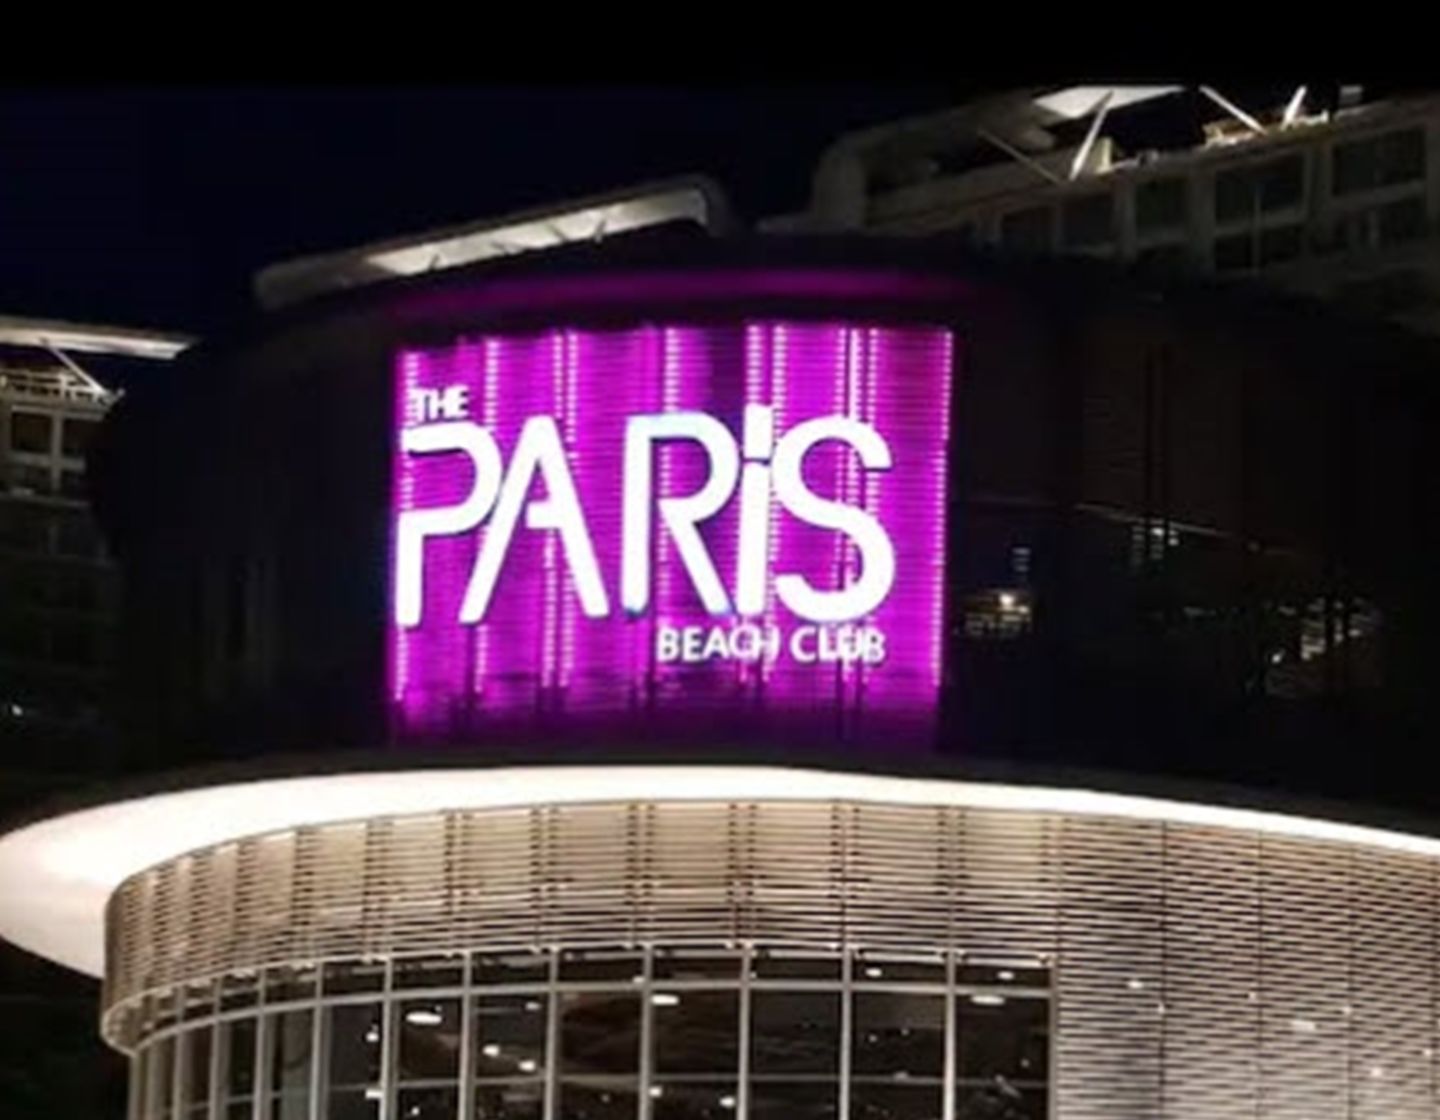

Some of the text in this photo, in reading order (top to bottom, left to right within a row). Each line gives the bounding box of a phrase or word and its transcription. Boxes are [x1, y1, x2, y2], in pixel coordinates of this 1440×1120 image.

[411, 386, 470, 421] THE
[656, 624, 886, 663] BEACH CLUB
